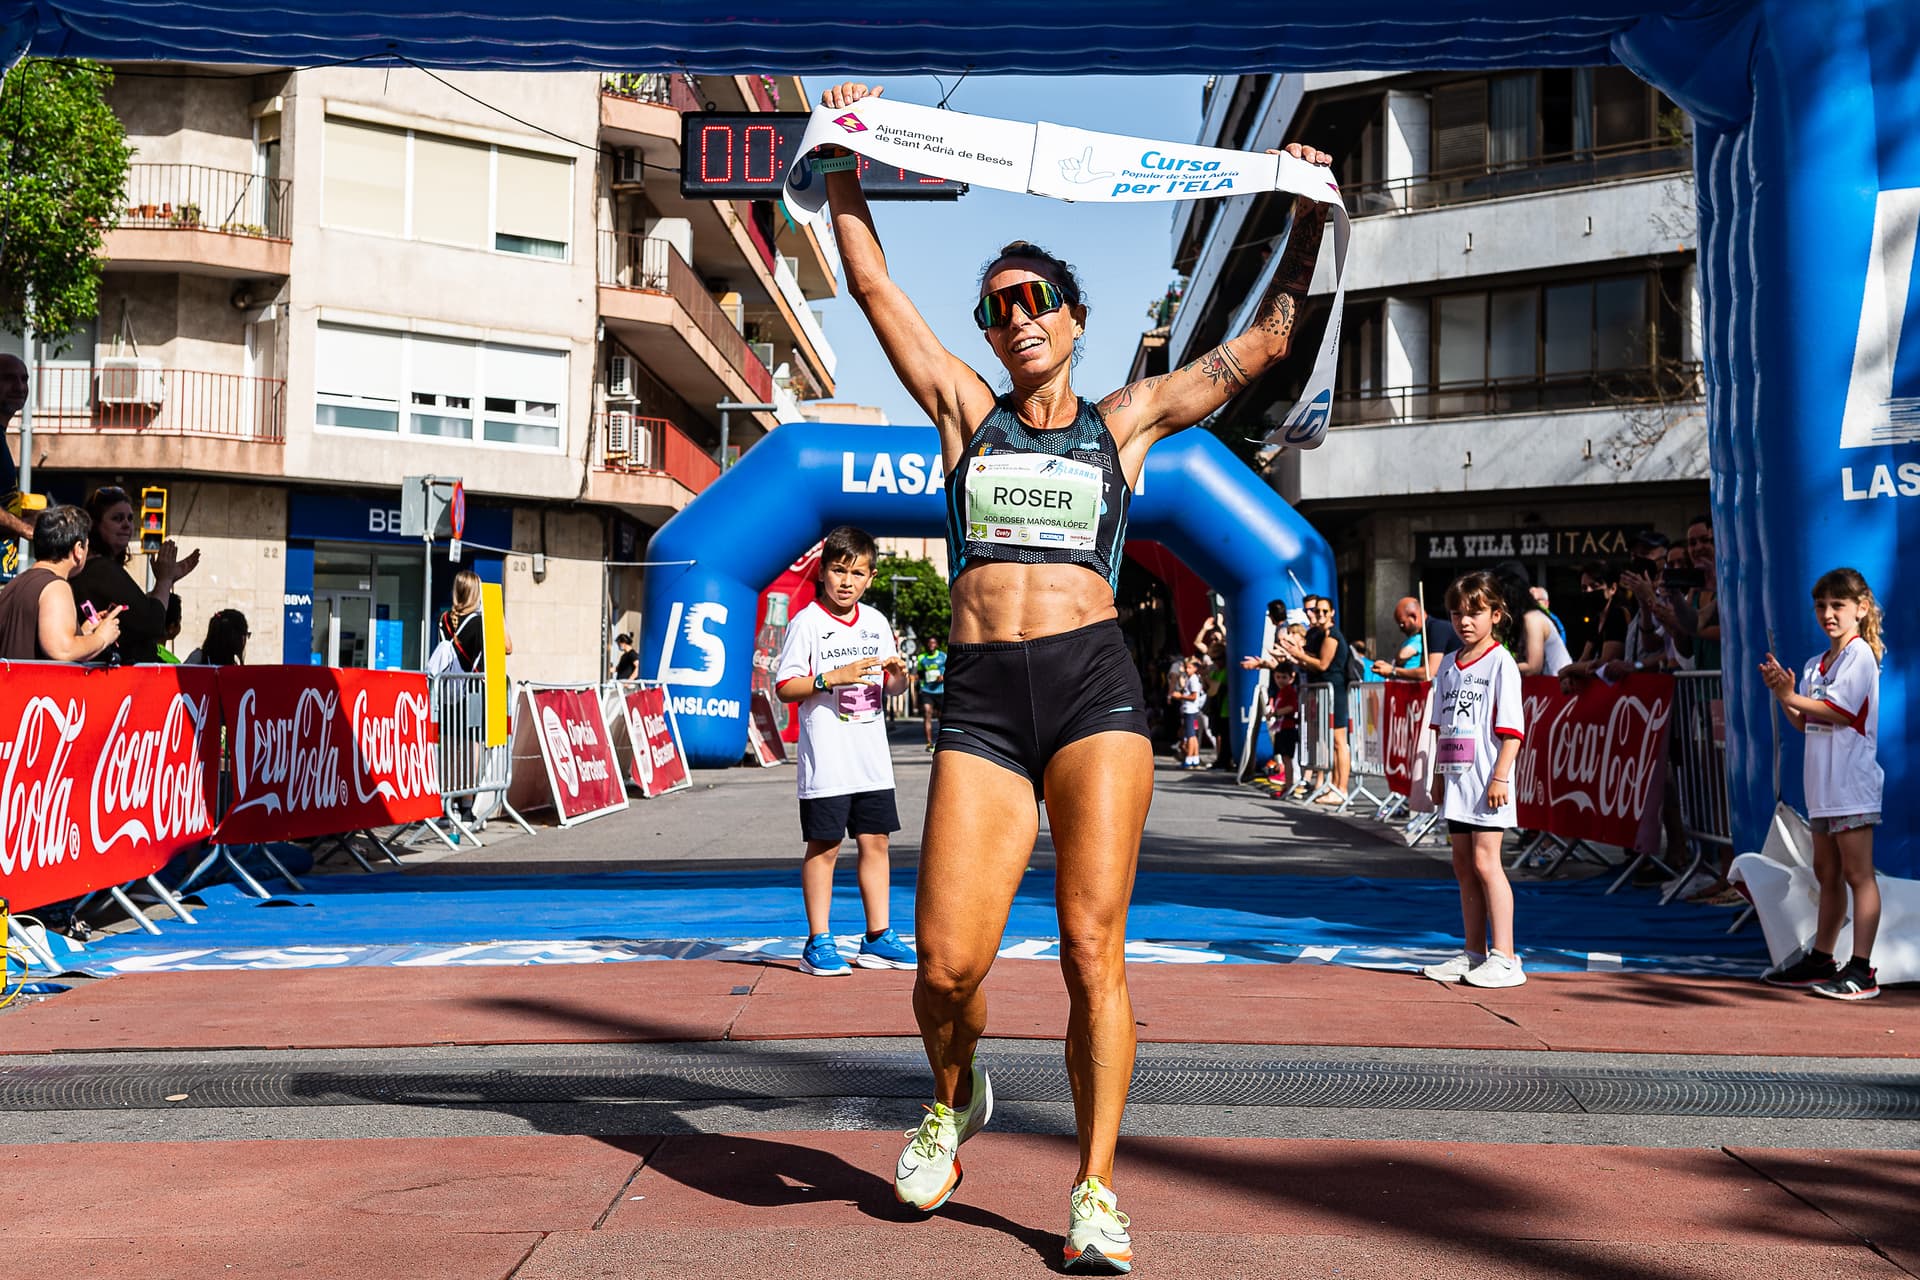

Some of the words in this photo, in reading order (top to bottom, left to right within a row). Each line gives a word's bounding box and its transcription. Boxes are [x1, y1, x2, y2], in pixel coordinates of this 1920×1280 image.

[876, 123, 944, 145] Ajuntament
[875, 132, 887, 143] de
[893, 135, 920, 153] Sant
[923, 142, 955, 158] Adrià
[958, 148, 973, 160] de
[976, 152, 1014, 168] Besòs
[1141, 150, 1221, 172] Cursa
[1122, 169, 1164, 181] Popular
[1112, 182, 1161, 197] per
[1166, 177, 1234, 194] l'ELA
[993, 486, 1073, 510] ROSER
[984, 515, 998, 523] 400
[1000, 516, 1025, 525] ROSER
[1027, 517, 1062, 528] MAÑOSA
[1063, 519, 1089, 530] LÓPEZ
[263, 547, 279, 559] 22
[1429, 537, 1458, 559] LA
[1463, 534, 1515, 557] VILA
[1520, 533, 1549, 555] DE
[1556, 530, 1628, 554] ITACA
[513, 561, 527, 572] 20
[284, 594, 312, 606] BBVA
